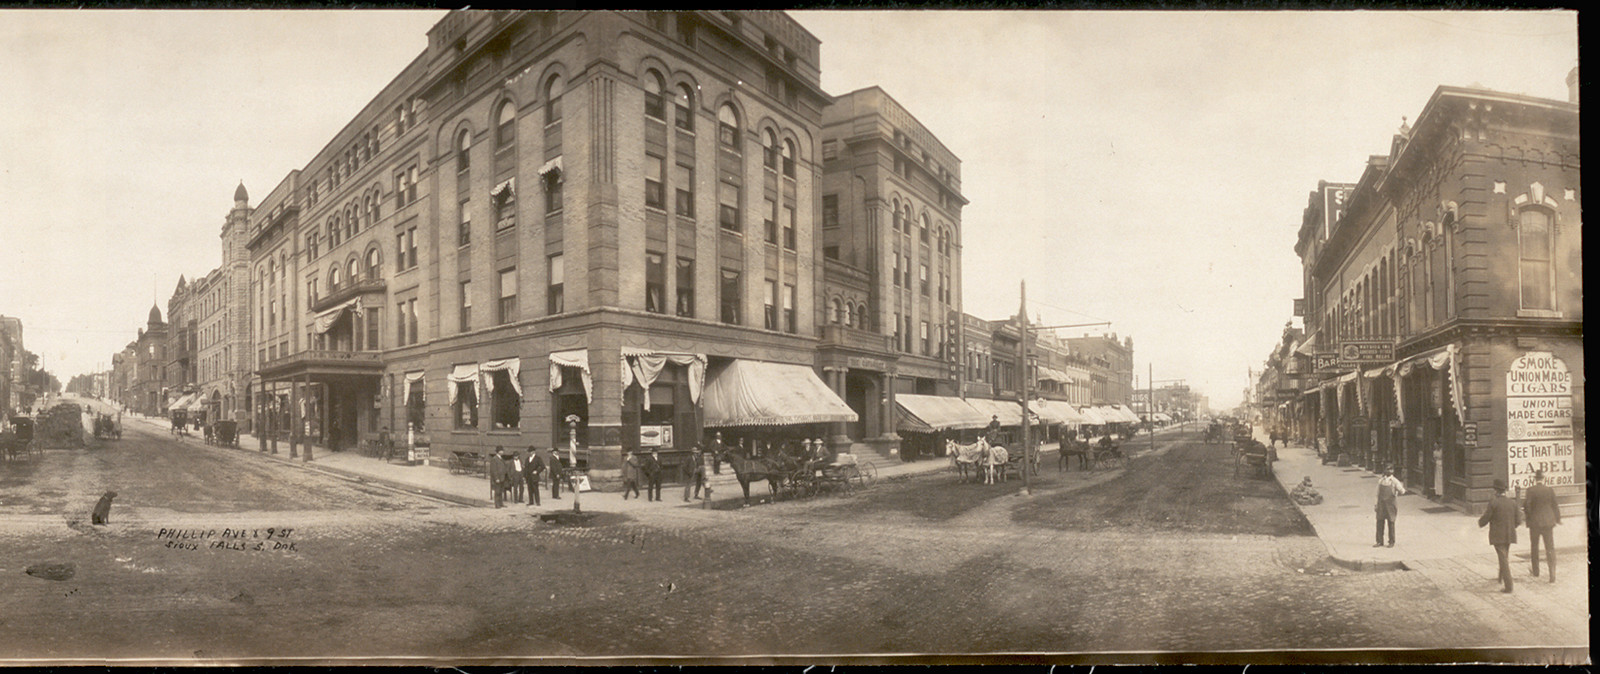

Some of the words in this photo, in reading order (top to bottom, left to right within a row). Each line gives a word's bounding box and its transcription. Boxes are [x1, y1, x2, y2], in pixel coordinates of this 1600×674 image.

[1518, 357, 1558, 369] SMOKE
[1510, 370, 1540, 382] UNION
[1542, 370, 1570, 382] MADE
[1511, 383, 1567, 393] CIGARS
[1522, 400, 1554, 408] UNION
[1508, 410, 1535, 419] MADE
[1538, 409, 1571, 418] CIGARS
[1509, 446, 1528, 458] SEE
[1529, 444, 1552, 457] THAT
[1552, 443, 1572, 456] THIS
[1510, 461, 1572, 475] LABEL
[1511, 479, 1520, 488] IS
[1523, 478, 1534, 487] ON
[1544, 476, 1555, 485] HE
[1557, 475, 1572, 484] BOX
